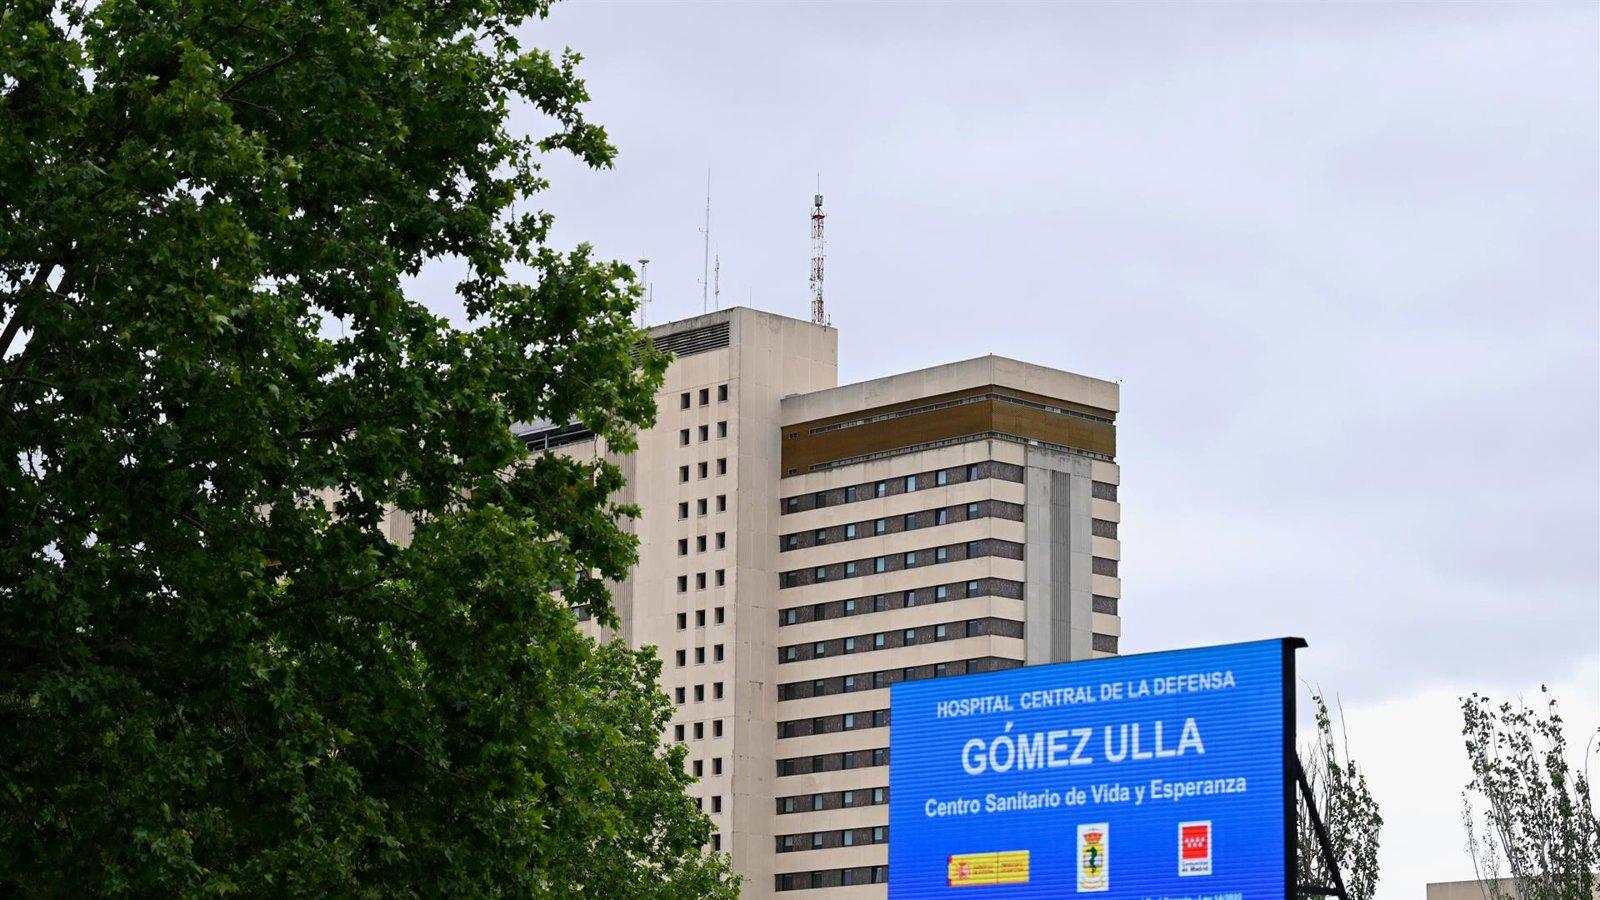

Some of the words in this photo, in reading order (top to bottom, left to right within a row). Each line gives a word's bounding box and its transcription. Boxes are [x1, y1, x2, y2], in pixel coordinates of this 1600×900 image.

[937, 695, 1014, 718] HOSPITAL
[1020, 686, 1096, 710] CENTRAL
[1100, 682, 1123, 701] DE
[1128, 679, 1150, 698] LA
[1153, 670, 1236, 696] DEFENSA
[961, 721, 1093, 776] GÓMEZ
[1104, 717, 1206, 763] ULLA
[925, 798, 981, 818] Centro
[985, 789, 1061, 813] Sanitario
[1065, 786, 1087, 806] de
[1091, 783, 1130, 804] Vida
[1134, 785, 1146, 806] y
[1150, 776, 1248, 802] Esperanza
